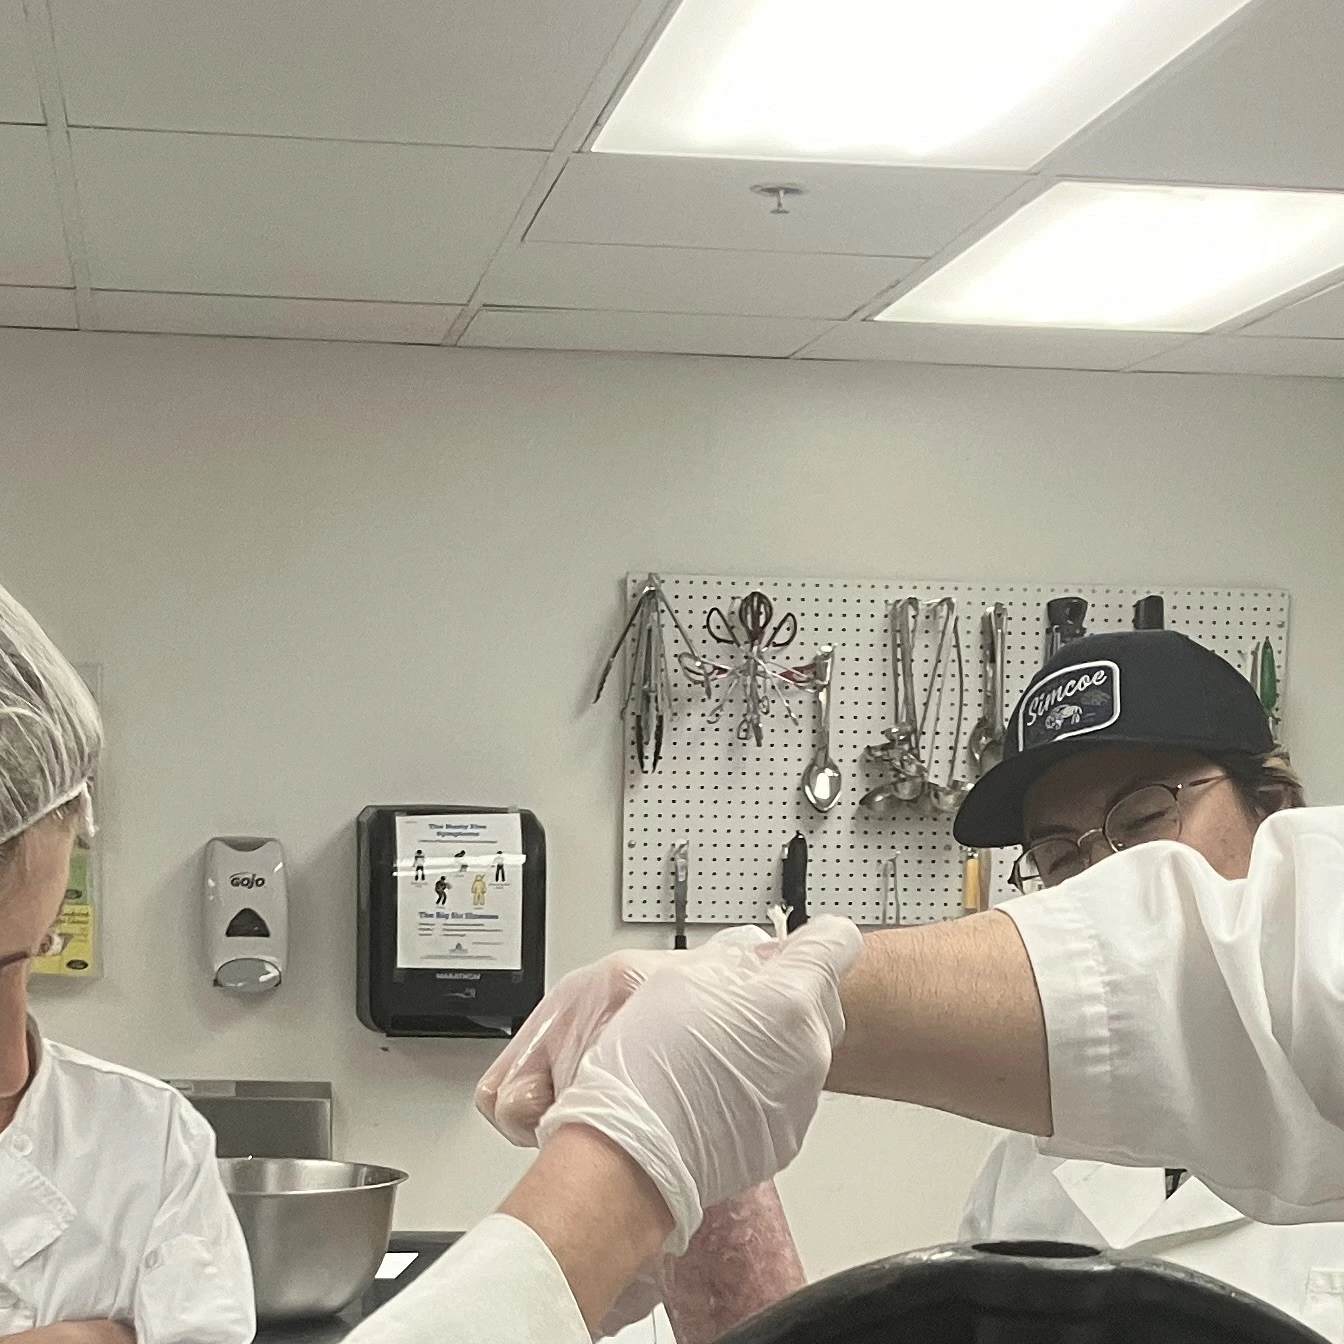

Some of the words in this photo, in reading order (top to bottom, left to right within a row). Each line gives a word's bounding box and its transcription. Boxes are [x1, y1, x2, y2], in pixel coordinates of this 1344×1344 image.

[1027, 669, 1107, 727] Simcoe
[418, 911, 434, 919] The
[436, 911, 450, 920] Big
